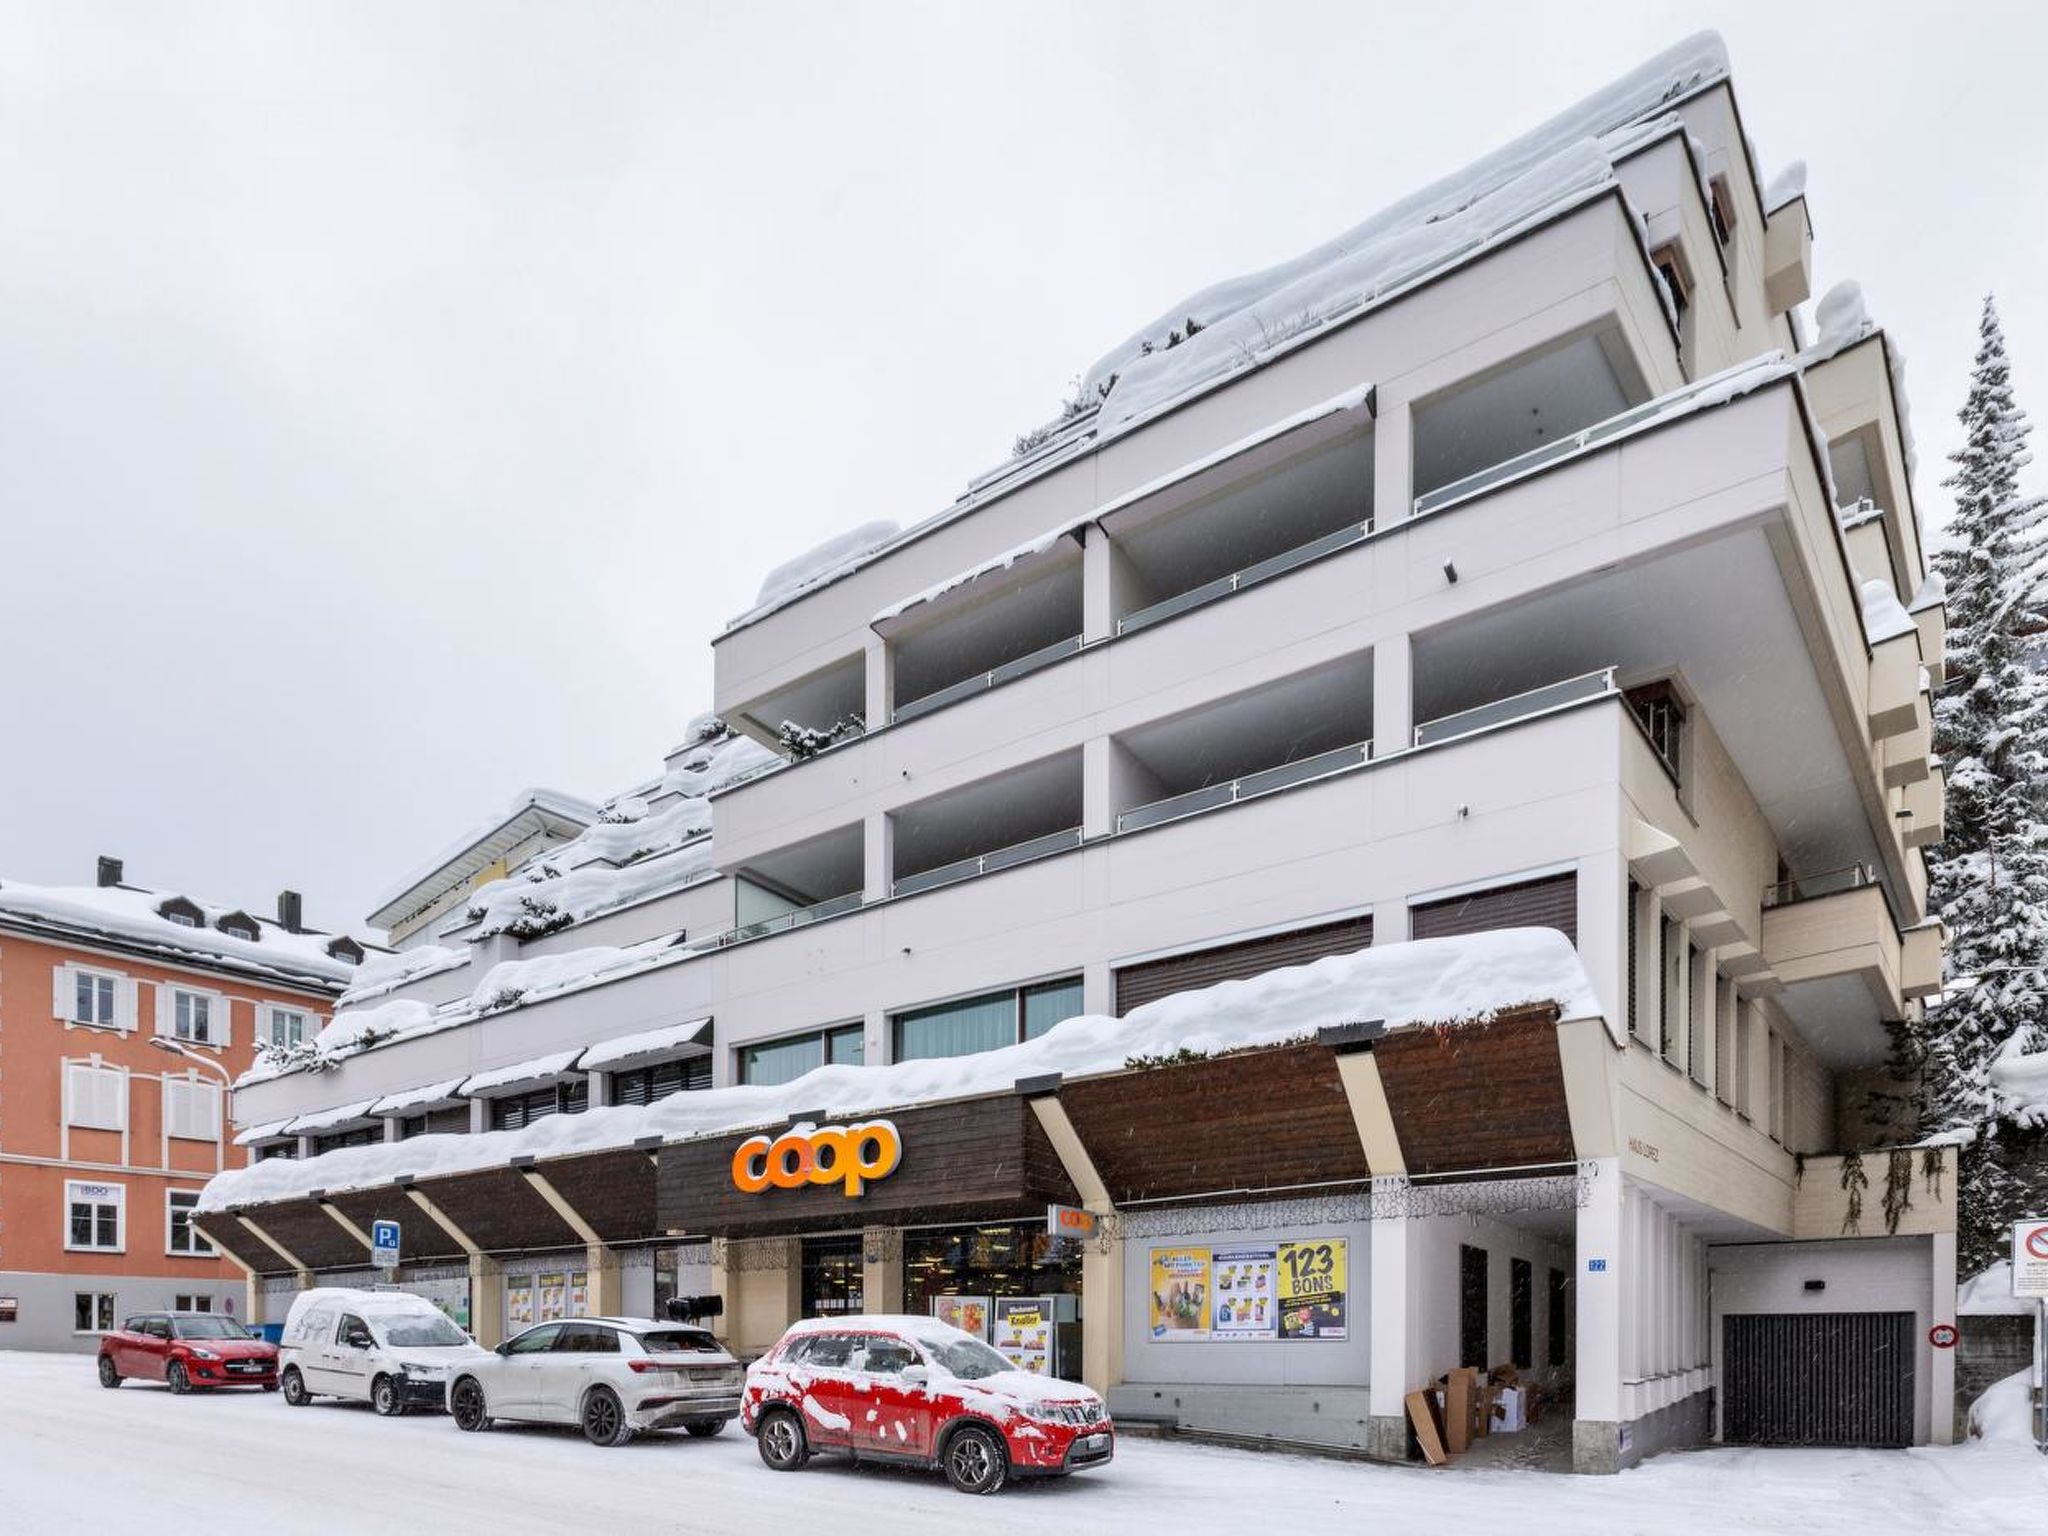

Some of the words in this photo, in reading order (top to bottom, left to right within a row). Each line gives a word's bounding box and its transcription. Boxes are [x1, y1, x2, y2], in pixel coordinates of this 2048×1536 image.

[732, 1123, 901, 1197] coop
[379, 1228, 392, 1245] P
[1283, 1244, 1334, 1279] 123
[1292, 1275, 1333, 1295] BONS
